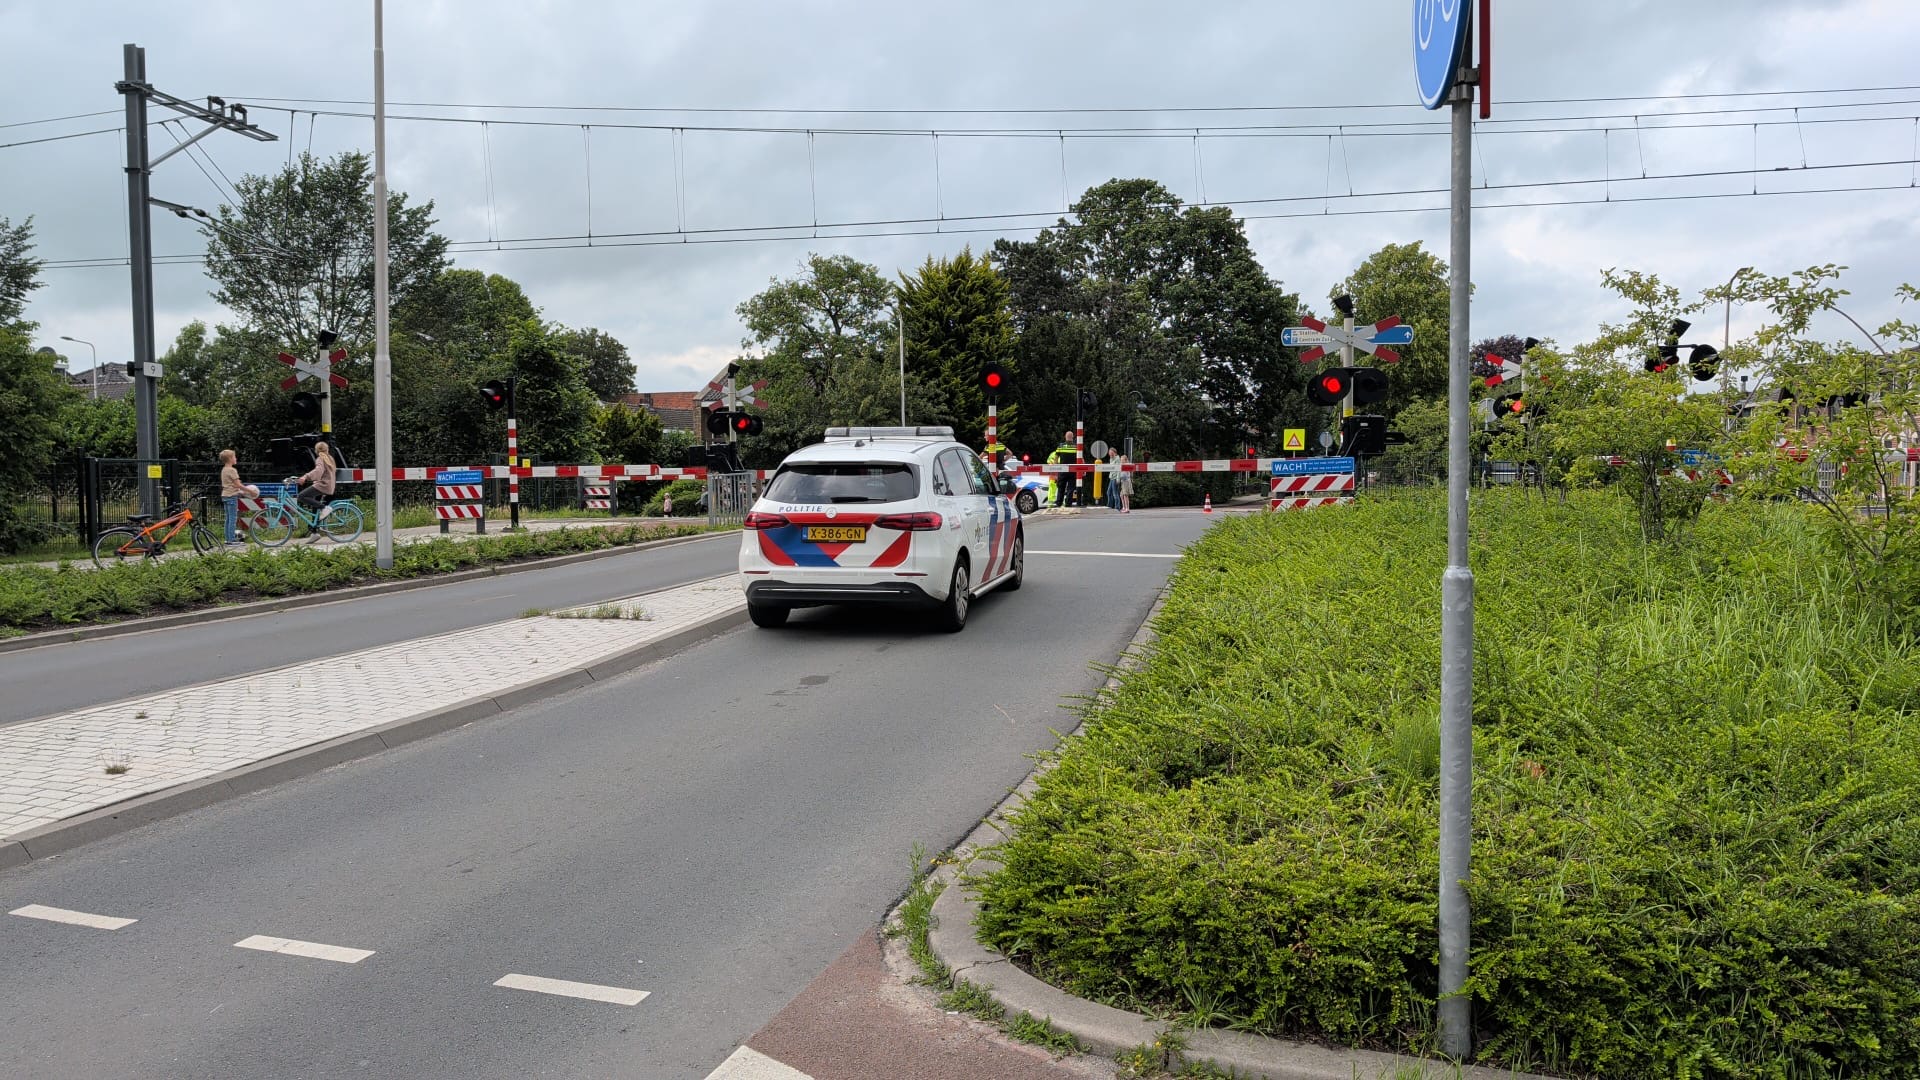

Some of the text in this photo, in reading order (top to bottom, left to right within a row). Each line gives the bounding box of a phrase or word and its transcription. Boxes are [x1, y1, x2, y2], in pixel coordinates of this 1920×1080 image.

[1274, 463, 1308, 471] WACHT
[438, 473, 456, 481] WACHT
[810, 529, 861, 539] X-386-GN
